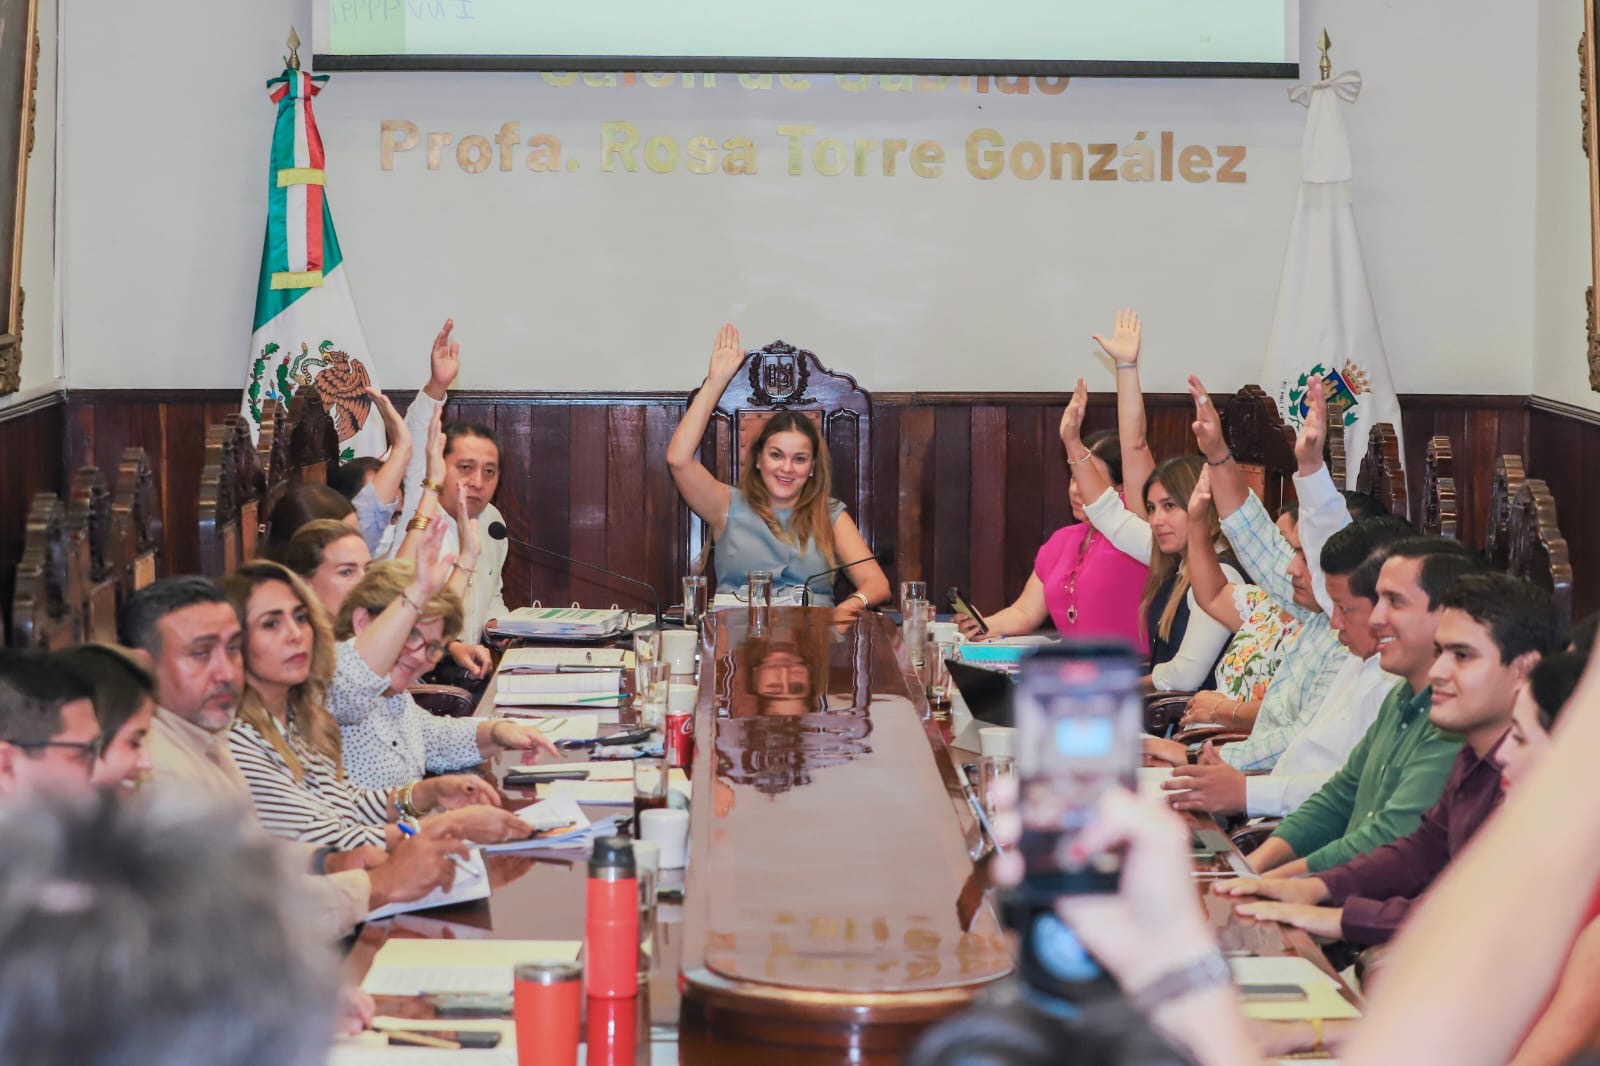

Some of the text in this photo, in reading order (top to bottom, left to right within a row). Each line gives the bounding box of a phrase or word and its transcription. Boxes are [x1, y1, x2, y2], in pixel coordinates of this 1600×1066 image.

[381, 119, 1246, 183] Profa. Rosa Torre González
